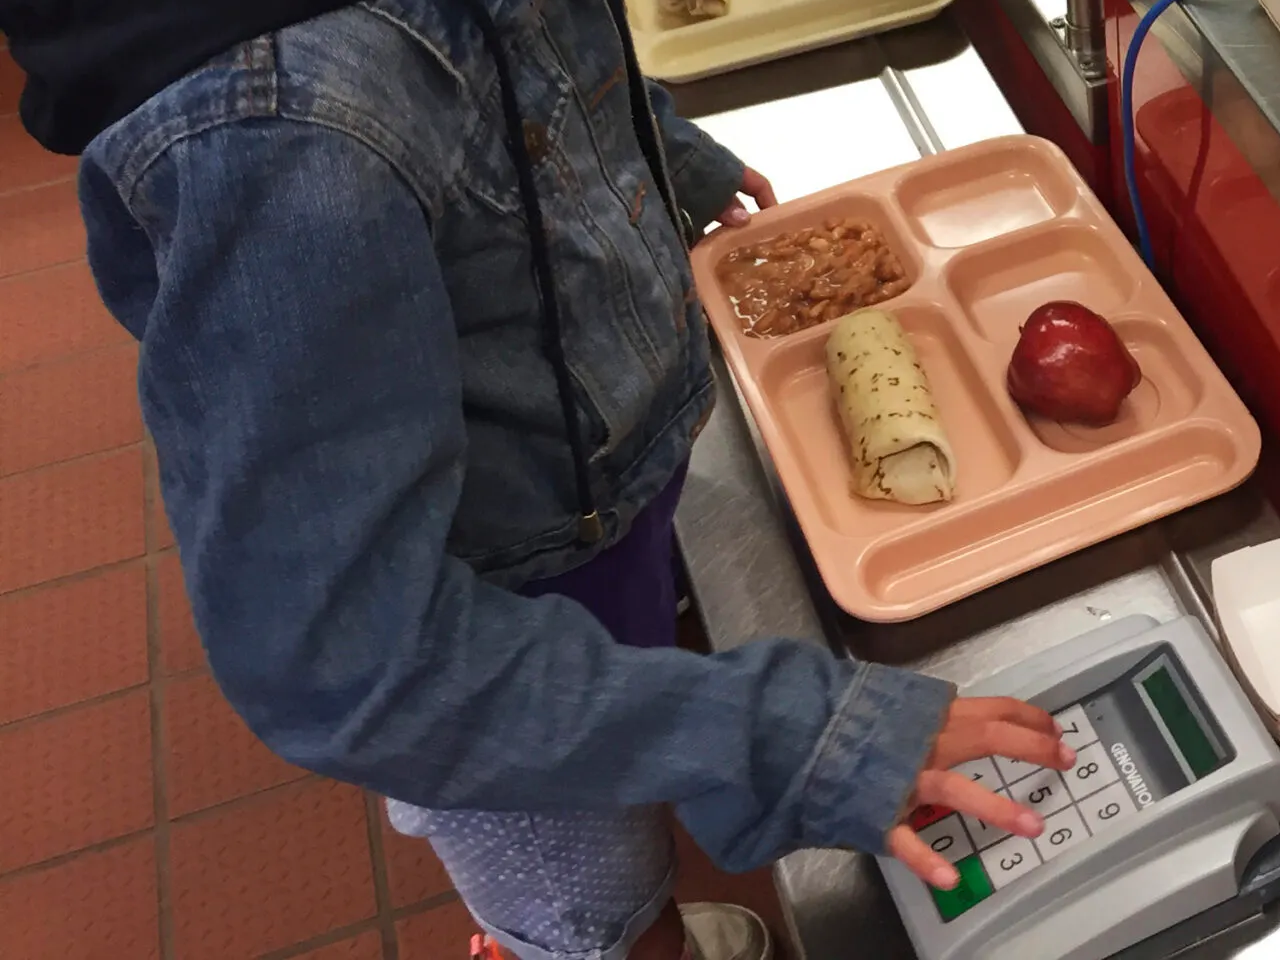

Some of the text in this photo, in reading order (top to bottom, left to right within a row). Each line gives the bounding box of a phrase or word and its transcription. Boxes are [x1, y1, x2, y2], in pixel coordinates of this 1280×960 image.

[1077, 762, 1099, 779] 8
[1028, 786, 1052, 804] 5
[1098, 803, 1120, 820] 9
[930, 835, 954, 853] 0
[1050, 828, 1072, 845] 6
[1000, 852, 1023, 871] 3
